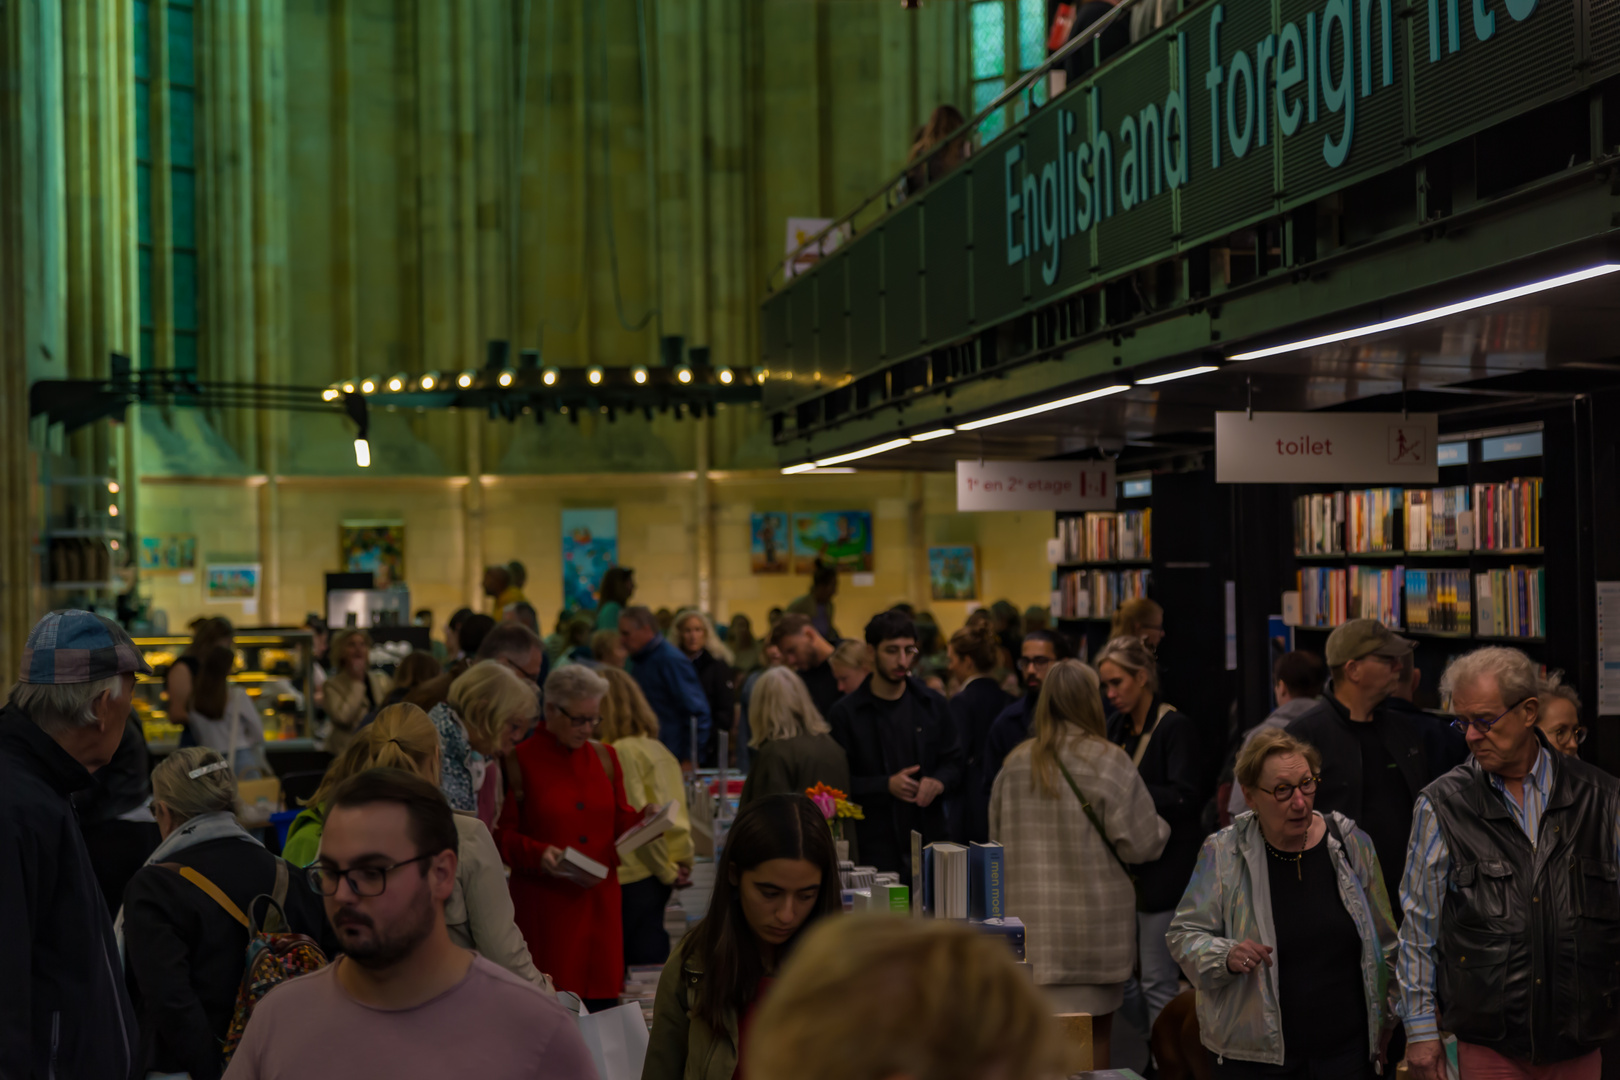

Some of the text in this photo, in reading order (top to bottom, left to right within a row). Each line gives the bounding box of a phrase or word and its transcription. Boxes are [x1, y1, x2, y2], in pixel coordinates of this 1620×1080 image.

[1005, 0, 1393, 286] English and foreign
[1276, 435, 1333, 457] toilet
[984, 480, 1003, 491] en
[1027, 479, 1072, 495] etage
